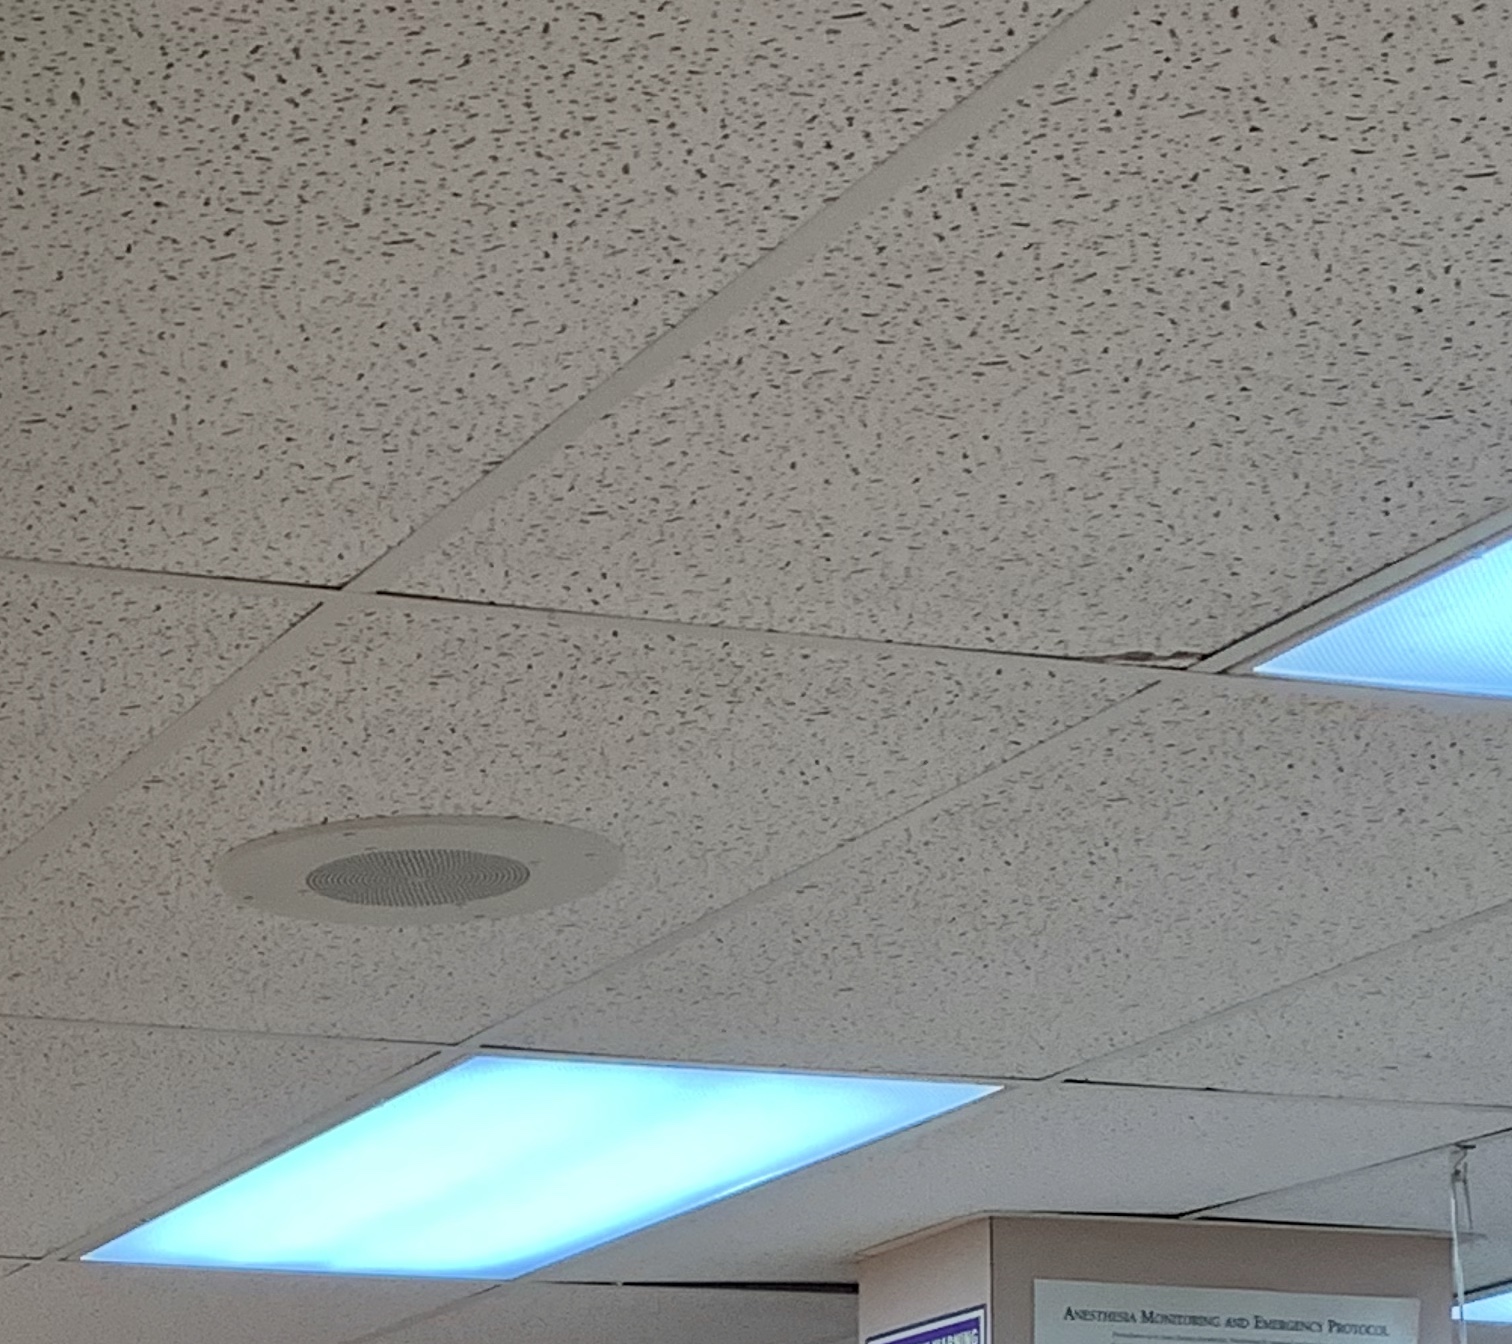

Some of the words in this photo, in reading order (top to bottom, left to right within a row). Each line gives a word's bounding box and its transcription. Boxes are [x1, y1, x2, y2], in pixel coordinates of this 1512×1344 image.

[1063, 1306, 1137, 1324] ANESTHESIA
[1140, 1309, 1221, 1328] MONITORING
[1225, 1316, 1249, 1330] AND
[1254, 1315, 1323, 1333] EMERGENCY
[1328, 1319, 1390, 1337] PROTOCOL
